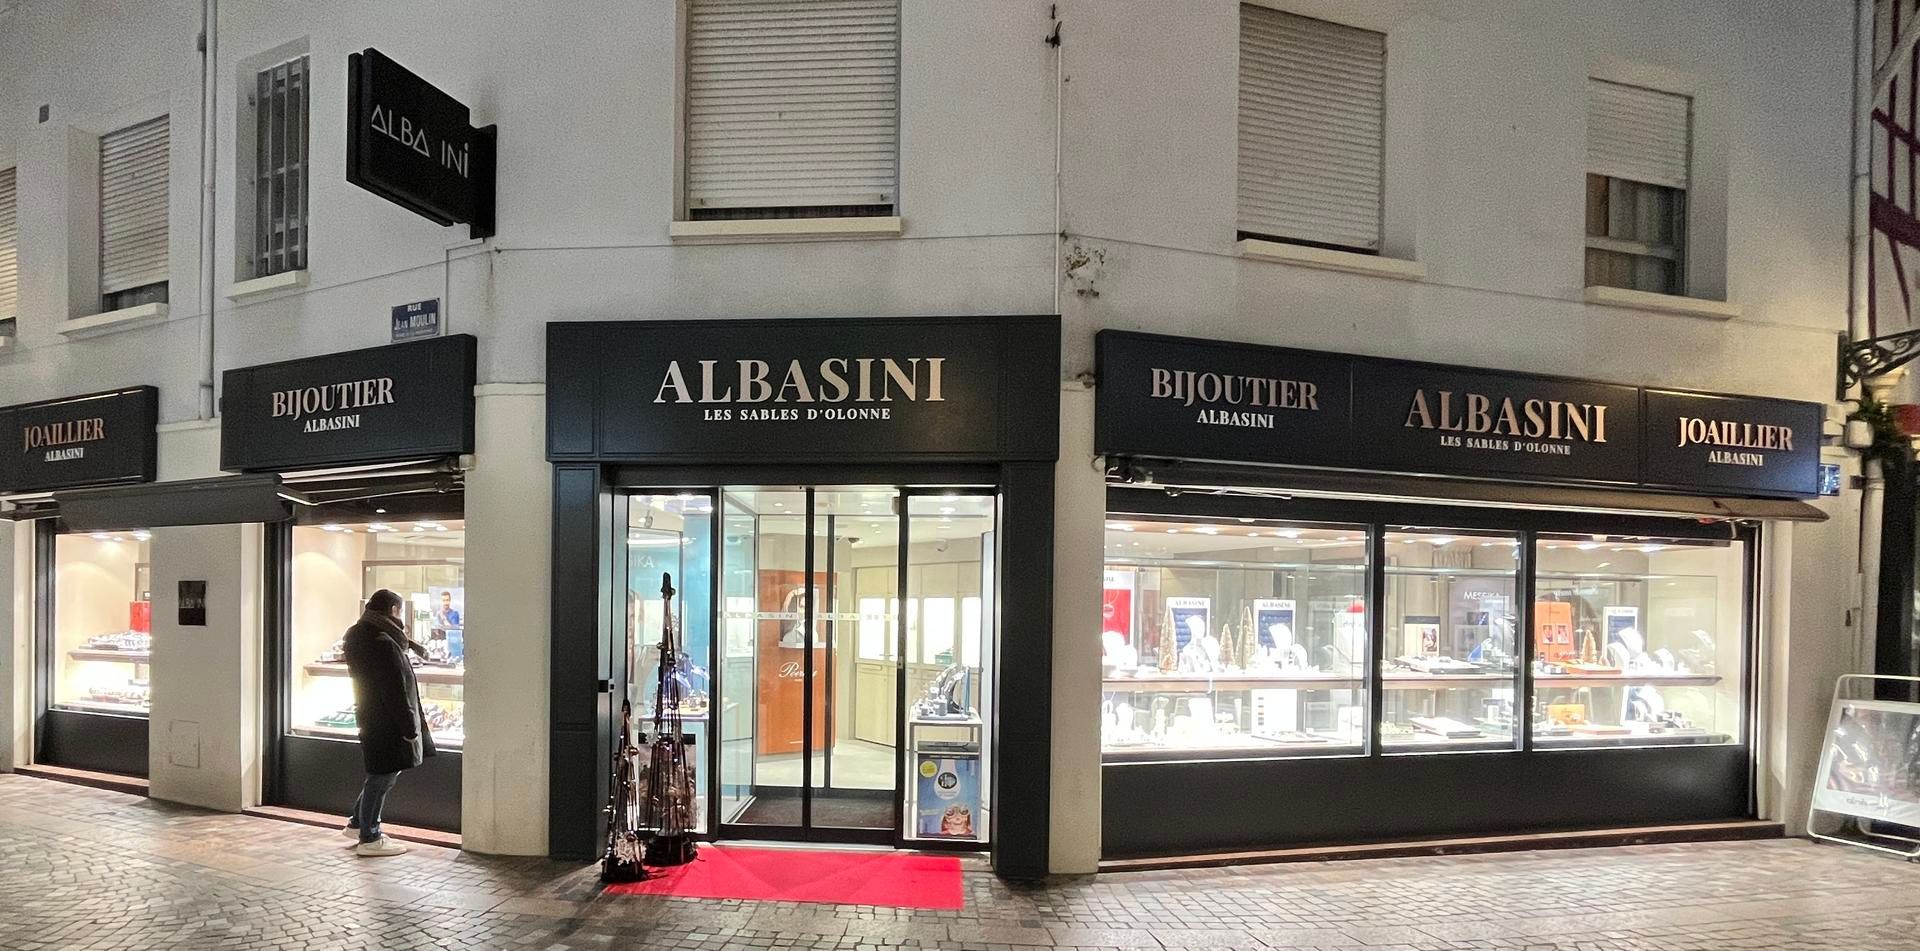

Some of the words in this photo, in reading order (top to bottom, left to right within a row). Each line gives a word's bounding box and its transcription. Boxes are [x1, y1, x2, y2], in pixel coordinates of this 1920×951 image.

[408, 303, 421, 312] RUE
[410, 313, 436, 328] MOULIN
[653, 358, 946, 403] ALBASINI
[1151, 368, 1319, 411] BIJOUTIER
[272, 378, 394, 420] BIJOUTIER
[304, 415, 360, 433] ALBASINI
[704, 410, 731, 421] LES
[740, 409, 799, 421] SABLES
[807, 409, 891, 421] D'OLONNE
[1197, 409, 1275, 429] ALBASINI
[1404, 389, 1608, 443] ALBASINI
[24, 418, 104, 454] JOAILLIER
[1678, 417, 1793, 451] JOAILLIER
[44, 448, 84, 462] ALBASINI
[1440, 436, 1461, 447] LES
[1467, 438, 1509, 450] SABLES
[1514, 443, 1571, 455] D'OLONNE
[1708, 451, 1764, 466] ALBASINI
